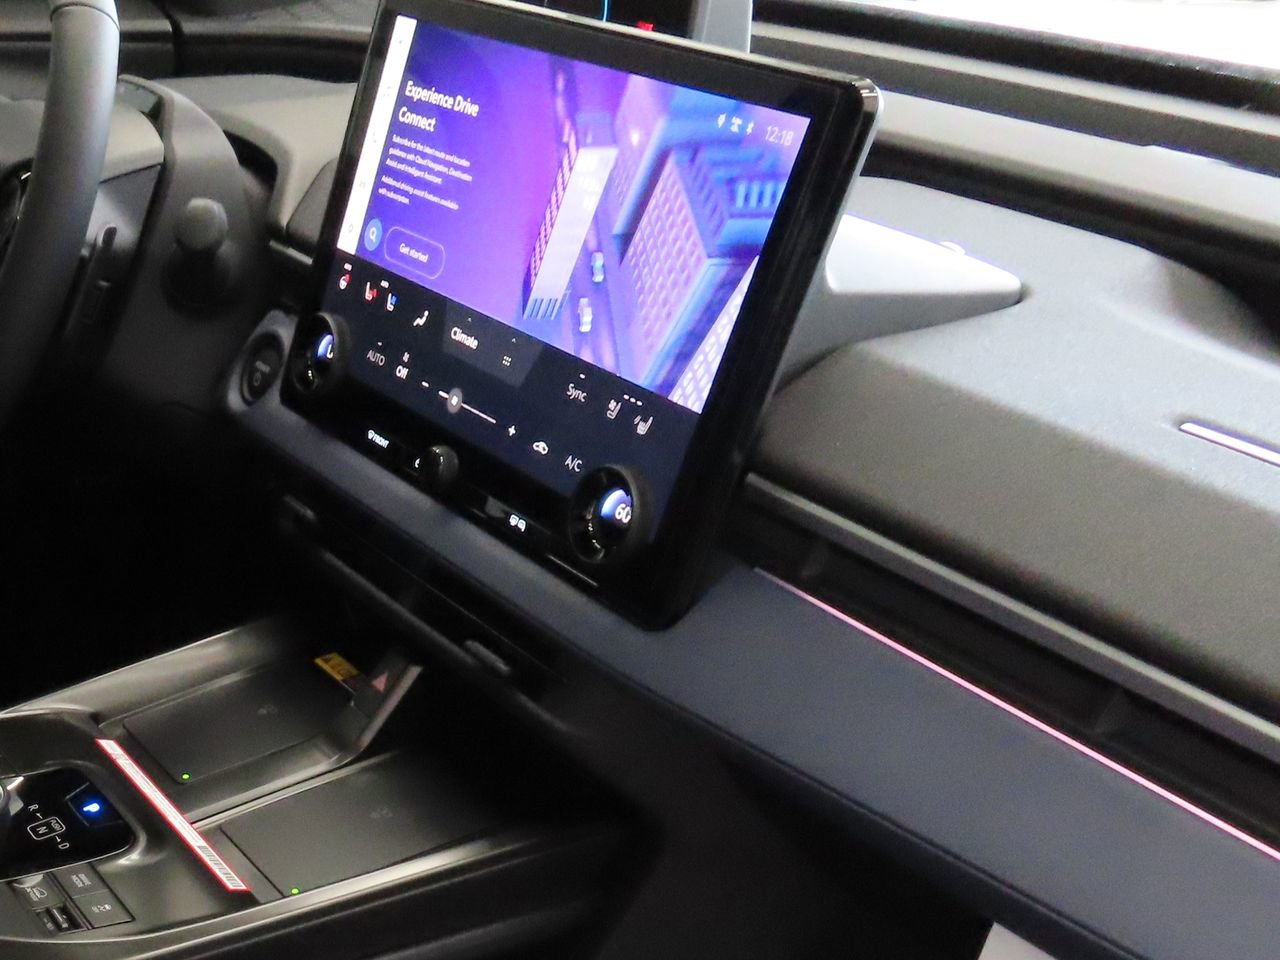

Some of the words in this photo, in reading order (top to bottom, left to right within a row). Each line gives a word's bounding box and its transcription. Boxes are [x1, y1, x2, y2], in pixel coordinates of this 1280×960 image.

[404, 80, 454, 109] Experience
[453, 95, 479, 117] Drive
[399, 106, 436, 132] Connect
[765, 126, 794, 146] 12:18
[400, 243, 410, 255] Get
[409, 248, 429, 263] started
[450, 326, 479, 350] Climate
[366, 349, 386, 367] AUTO
[395, 365, 409, 380] Off
[567, 383, 588, 403] Sync
[373, 430, 390, 449] FRONT
[564, 454, 583, 473] A/C
[27, 803, 39, 812] R
[58, 842, 70, 850] D
